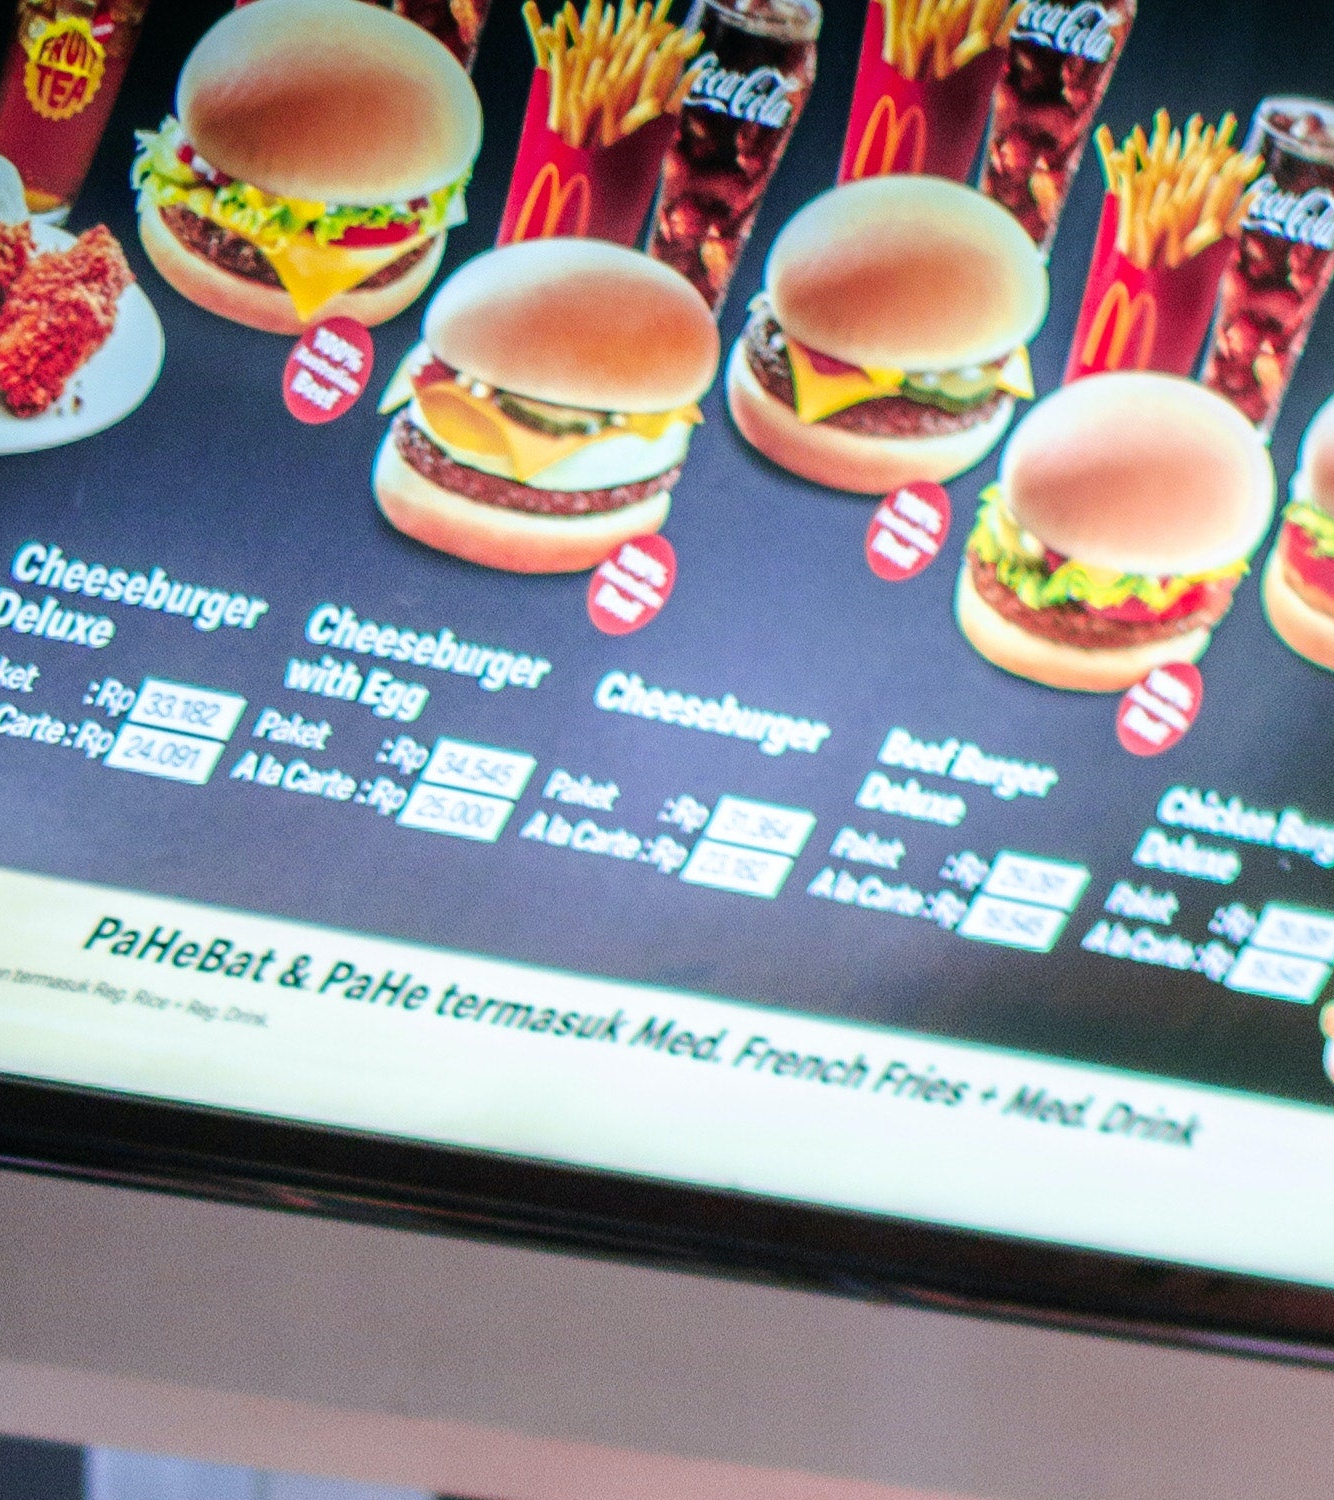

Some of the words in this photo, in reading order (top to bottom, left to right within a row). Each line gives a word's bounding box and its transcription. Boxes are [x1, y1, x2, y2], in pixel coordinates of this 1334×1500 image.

[36, 63, 88, 109] TEA
[11, 539, 270, 631] Cheeseburger
[305, 601, 552, 692] Cheeseburger
[143, 692, 221, 727] 33.182
[283, 655, 363, 701] with
[358, 666, 430, 723] Egg
[593, 669, 832, 756] Cheeseburger
[122, 735, 201, 770] 24.091
[251, 706, 333, 751] Paket
[437, 751, 516, 787] 34.545
[877, 726, 959, 776] Beef
[948, 742, 1059, 800] Burger
[229, 750, 258, 780] A
[255, 753, 284, 786] la
[415, 794, 495, 830] 25.000
[542, 767, 621, 812] Paket
[855, 770, 967, 827] Deluxe
[1157, 785, 1276, 845] Chicken
[519, 810, 548, 840] A
[545, 813, 574, 847] la
[829, 825, 905, 870] Paket
[807, 866, 835, 898] A
[84, 916, 274, 985] PaHeBat
[278, 954, 312, 991] &
[318, 960, 429, 1010] PaHe
[435, 983, 628, 1045] termasuk
[630, 1015, 725, 1063] Med.
[734, 1036, 871, 1089] French
[874, 1061, 969, 1107] Fries
[1003, 1085, 1093, 1129] Med.
[1098, 1102, 1201, 1147] Drink
